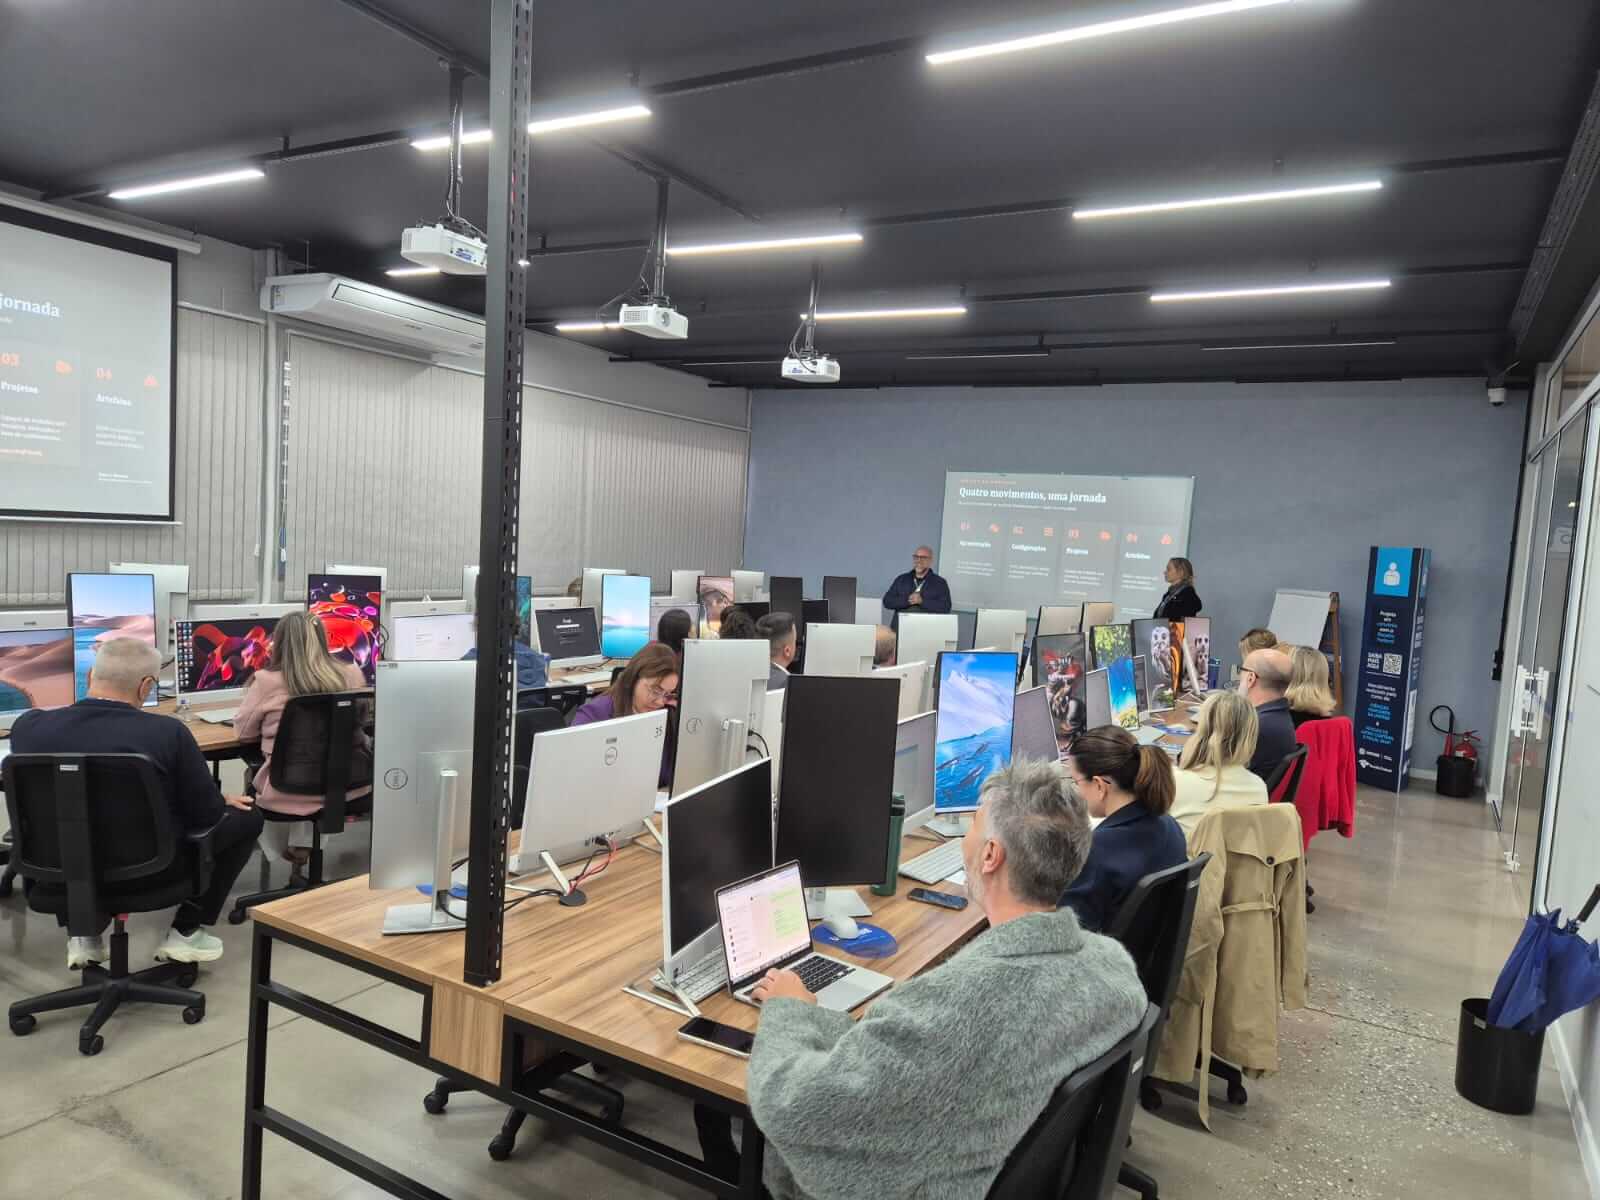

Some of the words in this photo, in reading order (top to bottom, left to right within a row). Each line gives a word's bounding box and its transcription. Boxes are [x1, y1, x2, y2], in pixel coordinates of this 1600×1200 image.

[959, 486, 989, 498] Quatro
[990, 489, 1046, 501] movimentos,
[1048, 492, 1068, 501] uma
[1069, 492, 1106, 504] jornada
